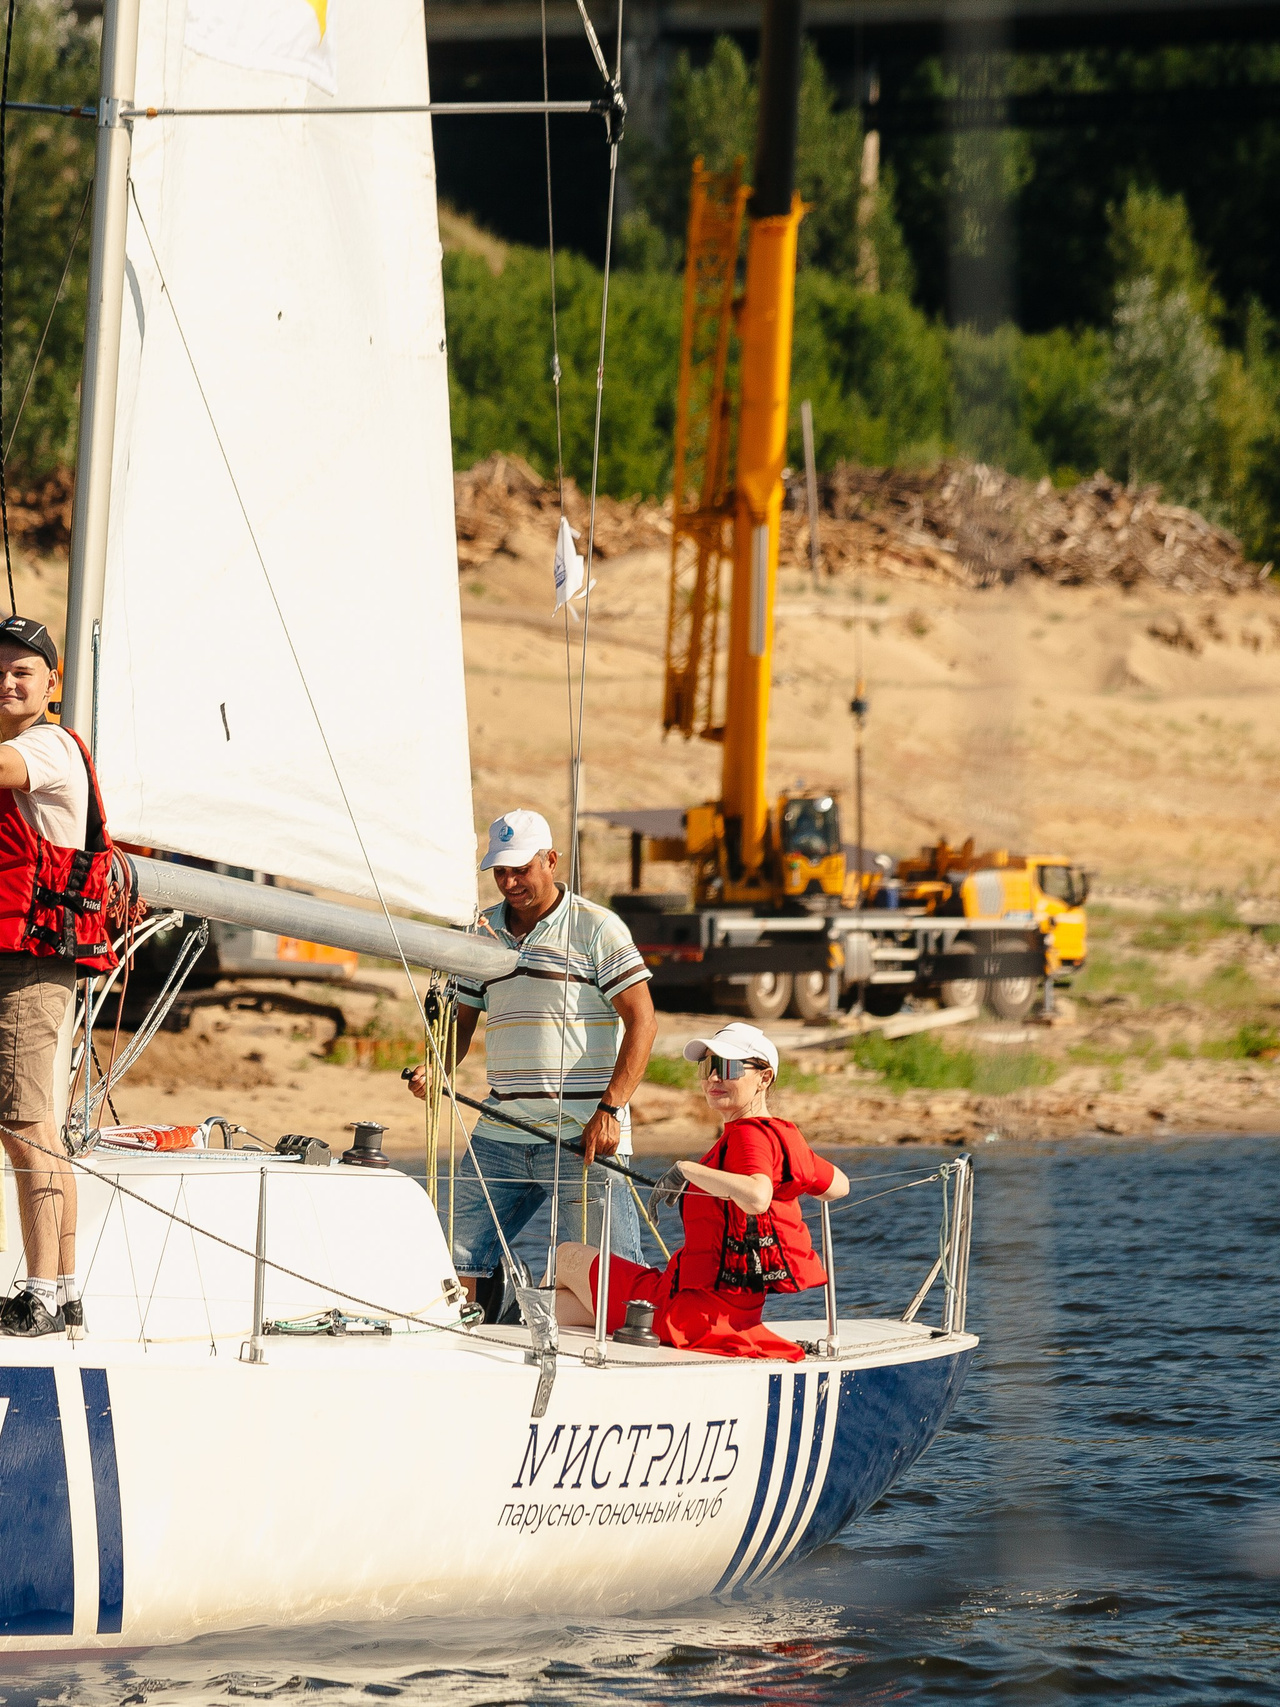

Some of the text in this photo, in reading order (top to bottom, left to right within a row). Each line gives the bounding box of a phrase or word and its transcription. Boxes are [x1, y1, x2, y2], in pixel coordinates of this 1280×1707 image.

[511, 1418, 739, 1489] МИСТРАЛЬ
[497, 1487, 728, 1534] парусно-гоночный клуб
